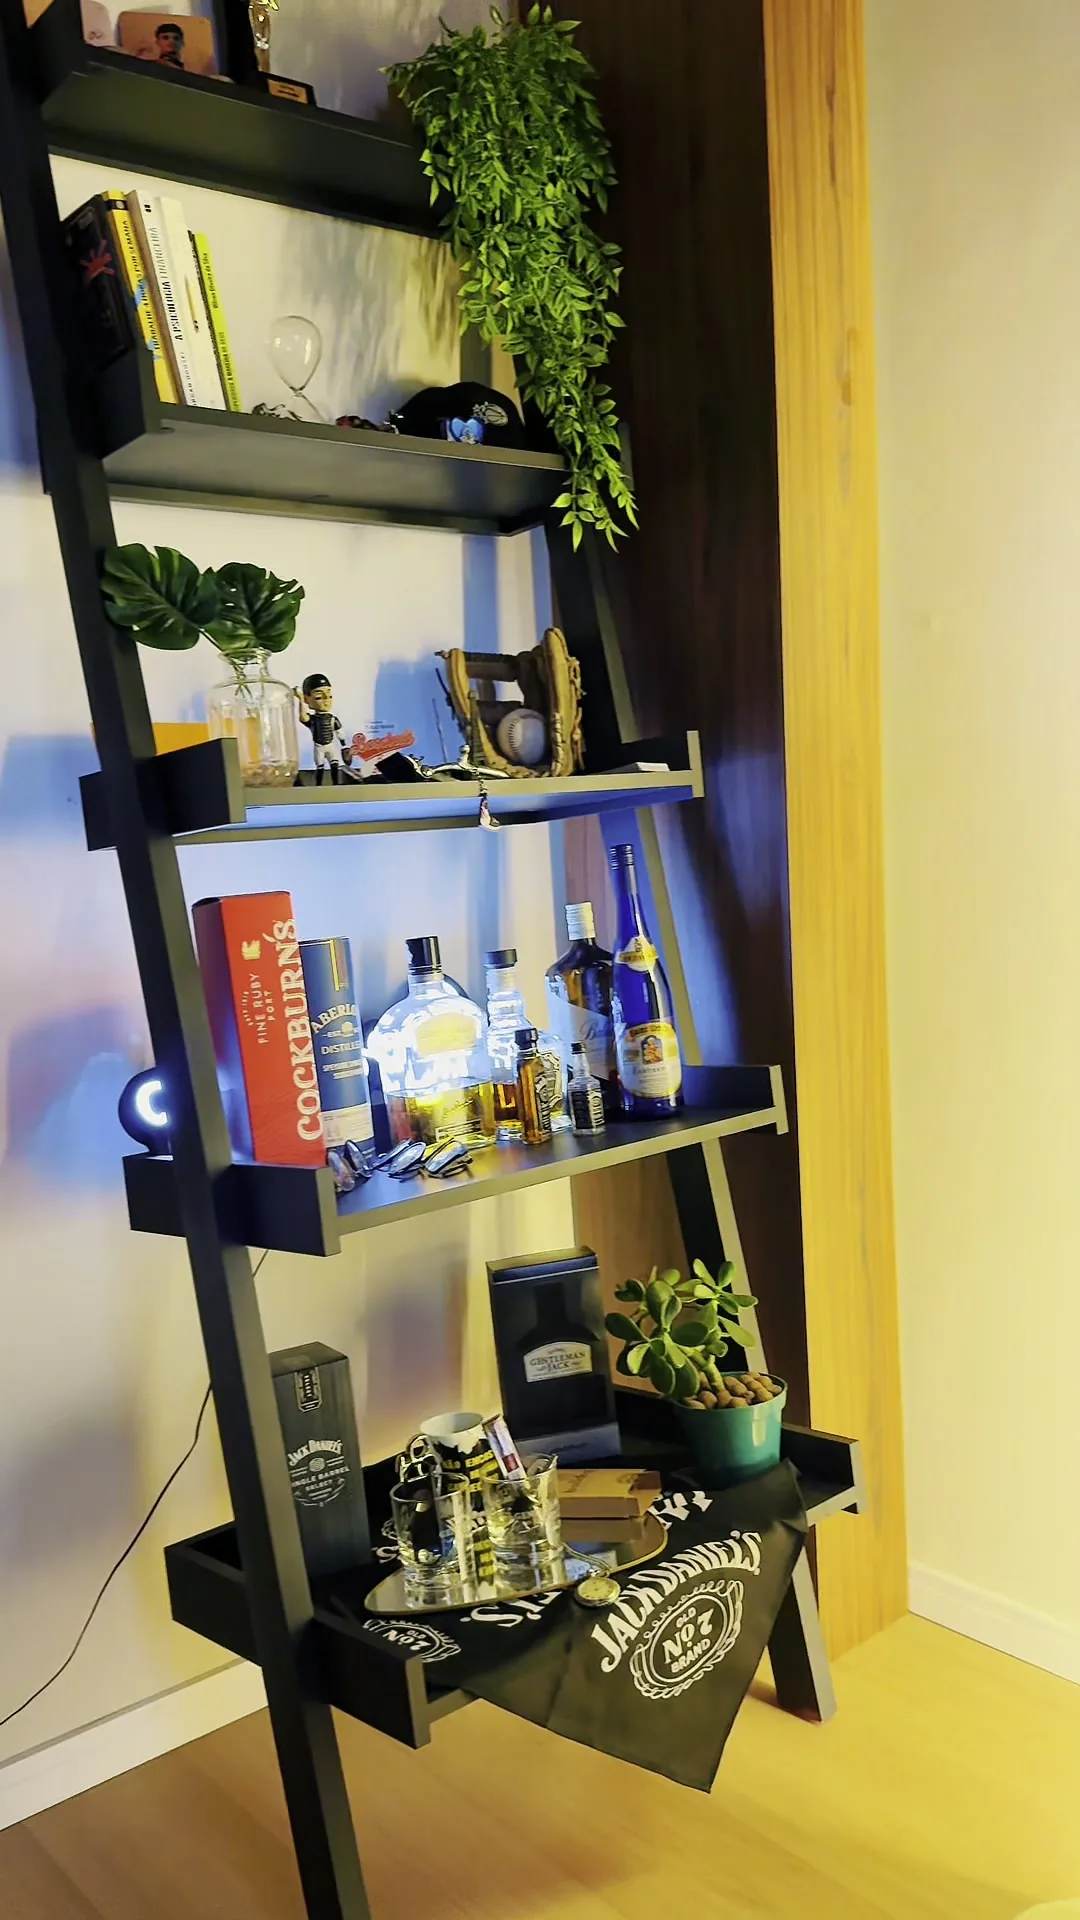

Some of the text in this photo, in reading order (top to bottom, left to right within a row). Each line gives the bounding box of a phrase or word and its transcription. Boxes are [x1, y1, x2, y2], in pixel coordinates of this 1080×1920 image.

[161, 281, 182, 333] PSICOLOGIA
[248, 973, 269, 1044] FINE RUBY
[263, 990, 276, 1021] PORT
[262, 918, 323, 1141] COCKBURN'S
[529, 1351, 586, 1367] GENTLEMAN
[547, 1361, 570, 1372] JACK
[287, 1439, 343, 1467] JACK DANIEL'S
[292, 1467, 351, 1487] INGLE BARREL
[306, 1479, 334, 1491] SELECT
[591, 1583, 665, 1673] JACK
[628, 1530, 762, 1596] DANIEL'S
[675, 1606, 697, 1628] OLD
[406, 1629, 427, 1640] OLD
[671, 1638, 711, 1673] BRAND
